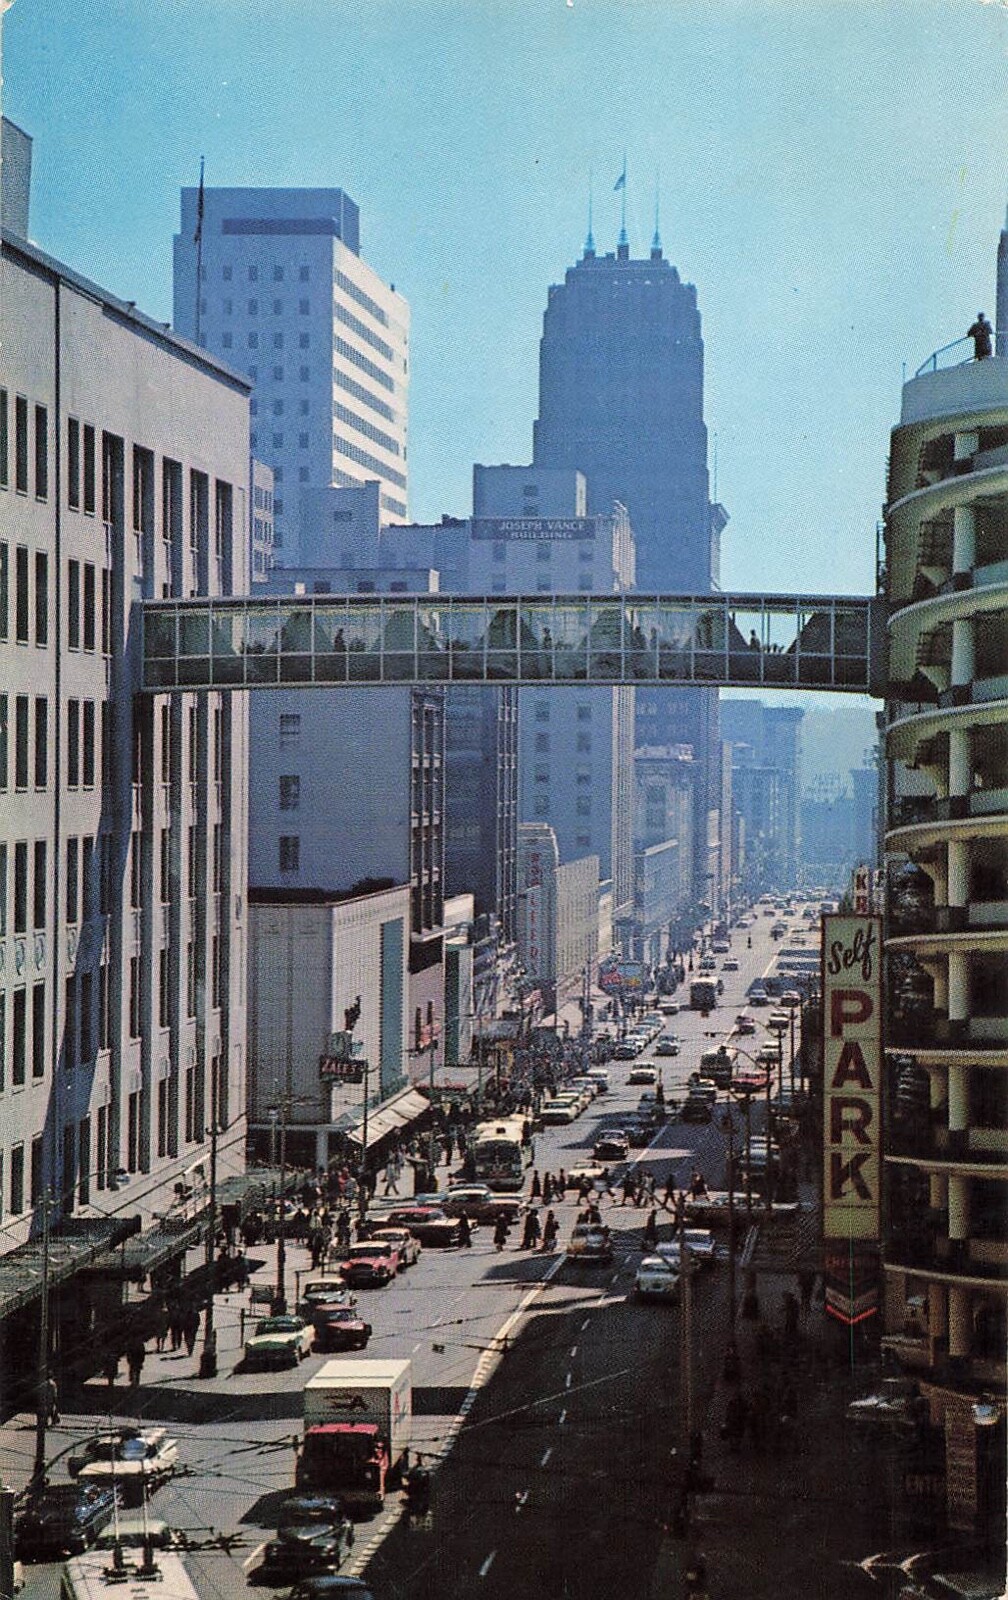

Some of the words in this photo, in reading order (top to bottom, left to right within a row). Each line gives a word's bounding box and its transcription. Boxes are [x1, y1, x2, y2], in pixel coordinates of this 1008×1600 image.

[498, 520, 543, 531] JOSEPH
[546, 520, 586, 531] VANCE
[510, 531, 573, 540] BUILDING
[826, 921, 877, 983] Self
[829, 988, 874, 1201] PARK
